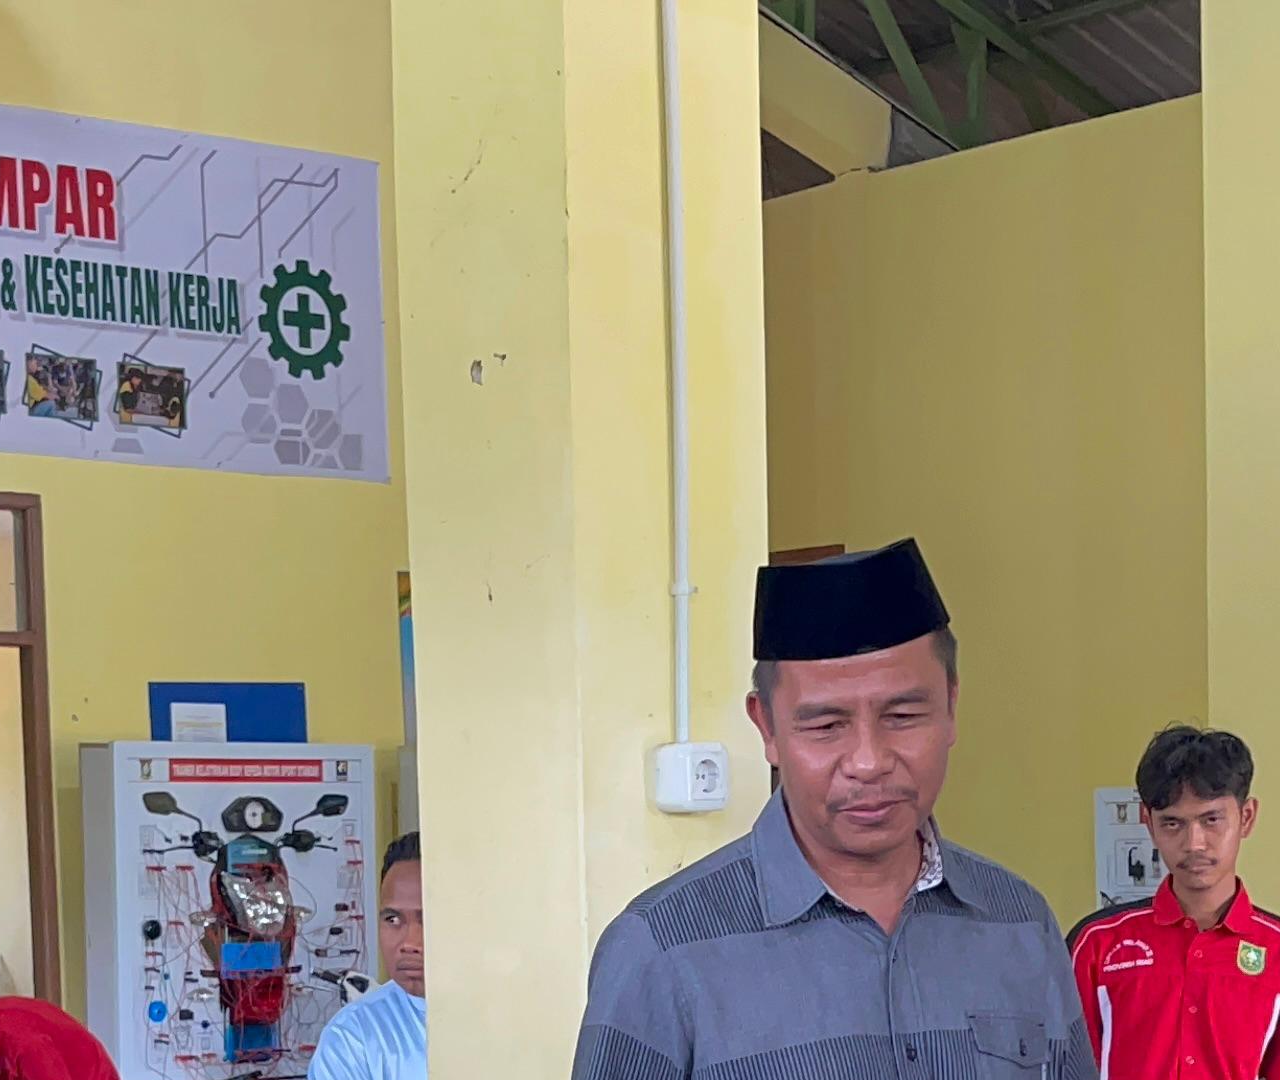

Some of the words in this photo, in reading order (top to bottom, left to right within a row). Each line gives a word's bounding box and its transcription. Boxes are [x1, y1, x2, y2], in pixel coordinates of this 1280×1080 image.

[0, 257, 18, 311] &
[24, 254, 160, 326] KESEHATAN
[168, 271, 242, 336] KERJA
